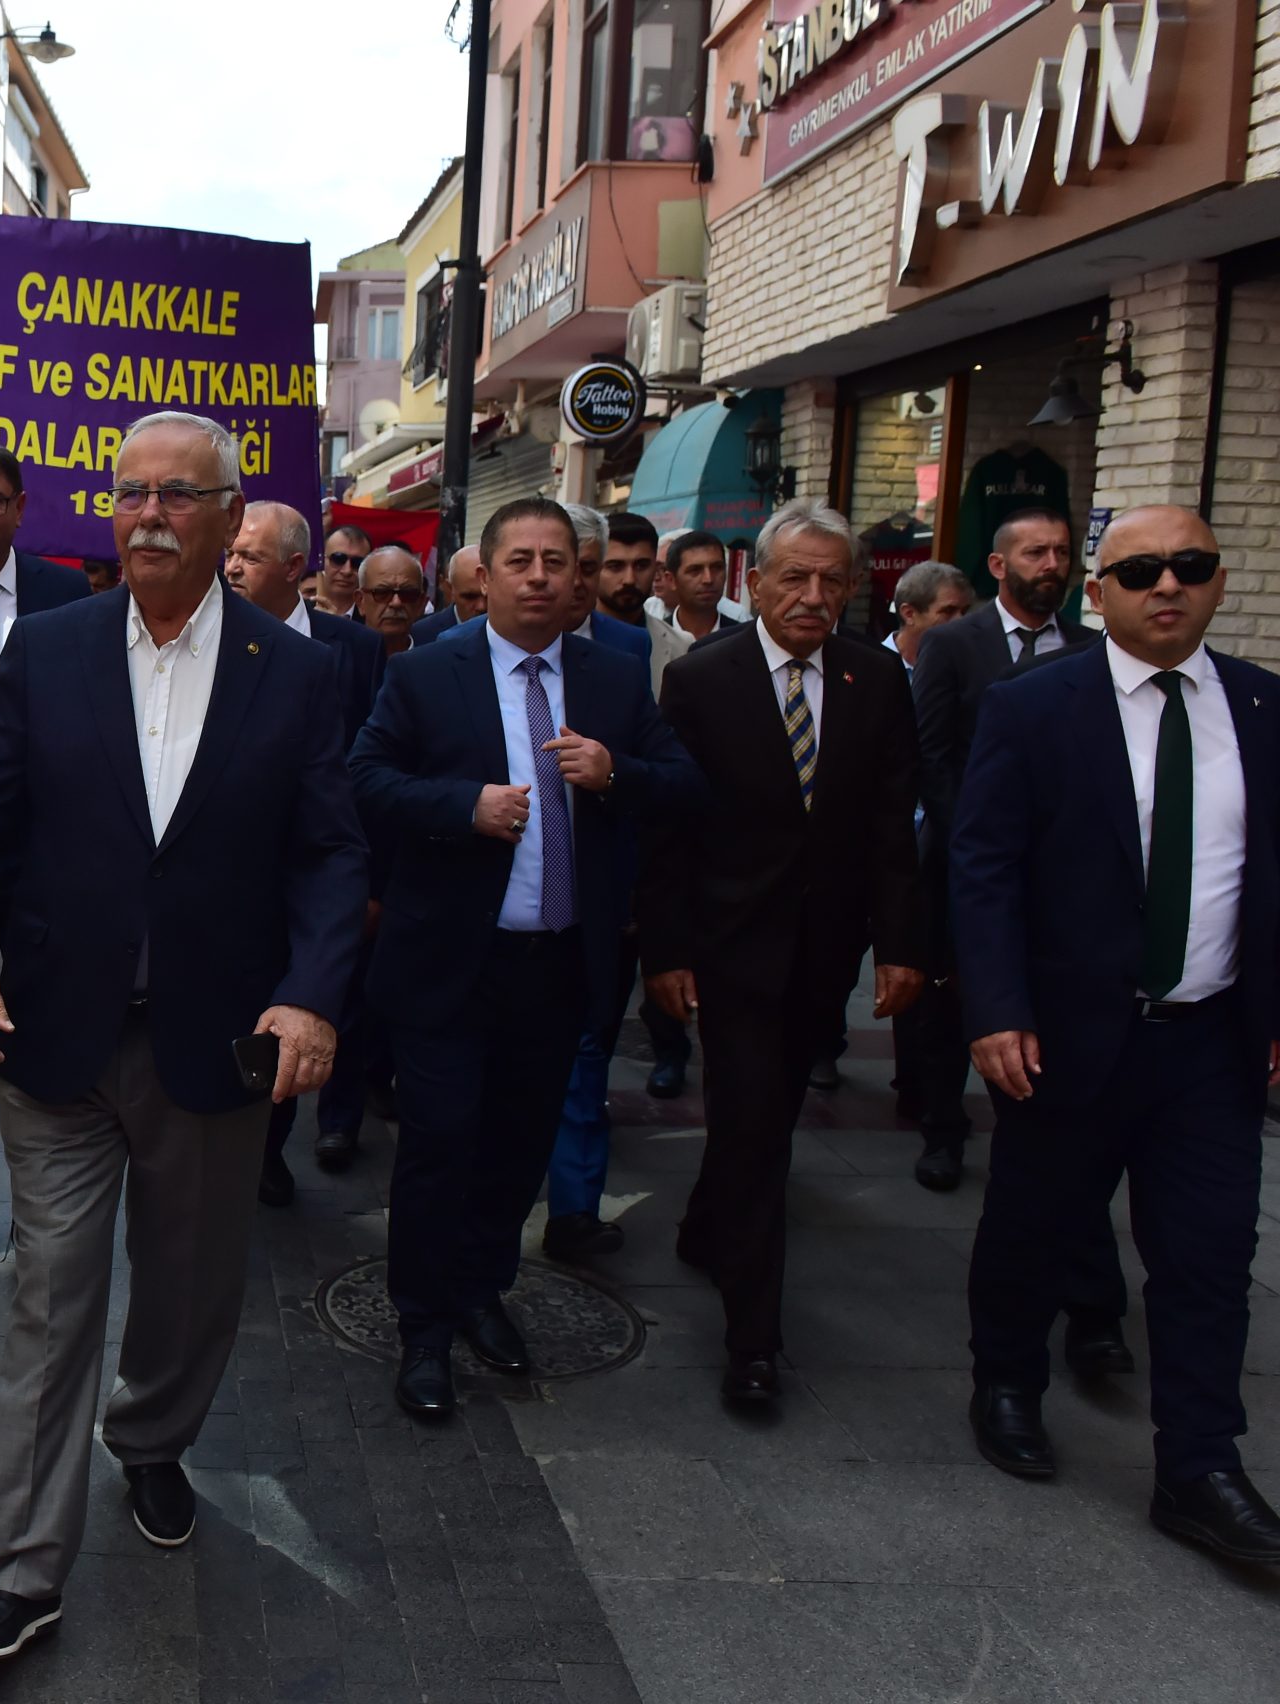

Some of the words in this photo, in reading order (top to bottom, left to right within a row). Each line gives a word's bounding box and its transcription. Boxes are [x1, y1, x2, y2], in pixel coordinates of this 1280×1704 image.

[788, 76, 872, 148] GAYRİMENKUL
[876, 30, 926, 87] EMLAK
[928, 0, 992, 49] YATIRIM
[17, 271, 240, 336] ÇANAKKALE
[28, 359, 73, 397] ve
[85, 353, 317, 407] SANATKARLAR
[574, 381, 632, 409] Tattoo
